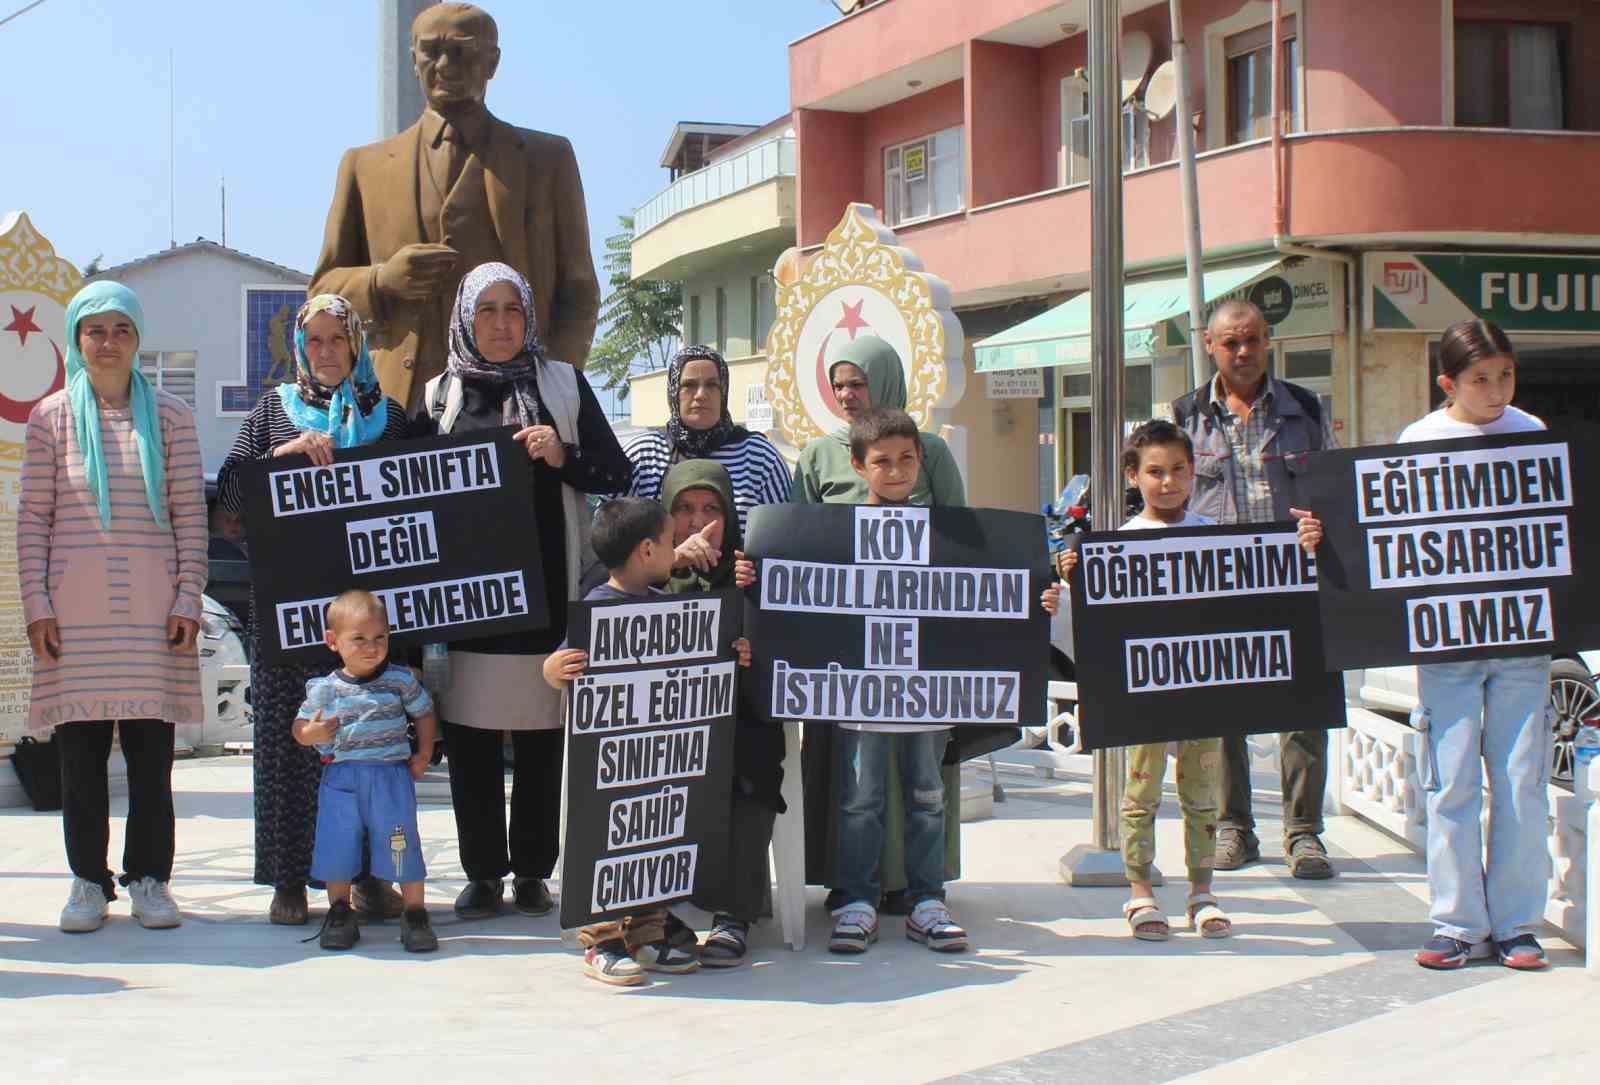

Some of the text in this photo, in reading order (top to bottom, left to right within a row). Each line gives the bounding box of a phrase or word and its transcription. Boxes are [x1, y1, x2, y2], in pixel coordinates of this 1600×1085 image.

[274, 447, 496, 513] ENGEL SINIFTA
[1361, 456, 1565, 517] EĞİTİMDEN
[350, 515, 438, 571] DEĞİL
[860, 509, 929, 561] KÖY
[1372, 522, 1564, 580] TASARRUF
[767, 564, 1023, 613] OKULLARINDAN
[1085, 536, 1317, 601] ÖĞRETMENİME
[593, 601, 716, 664] AKÇABÜK
[870, 622, 913, 666] NE
[1413, 594, 1547, 649] OLMAZ
[1129, 634, 1290, 689] DOKUNMA
[575, 667, 733, 731] ÖZEL EĞİTİM
[775, 662, 1016, 720] İSTİYORSUNUZ
[600, 730, 704, 784] SINIFINA
[611, 787, 685, 846] SAHİP
[596, 850, 692, 912] ÇIKIYOR
